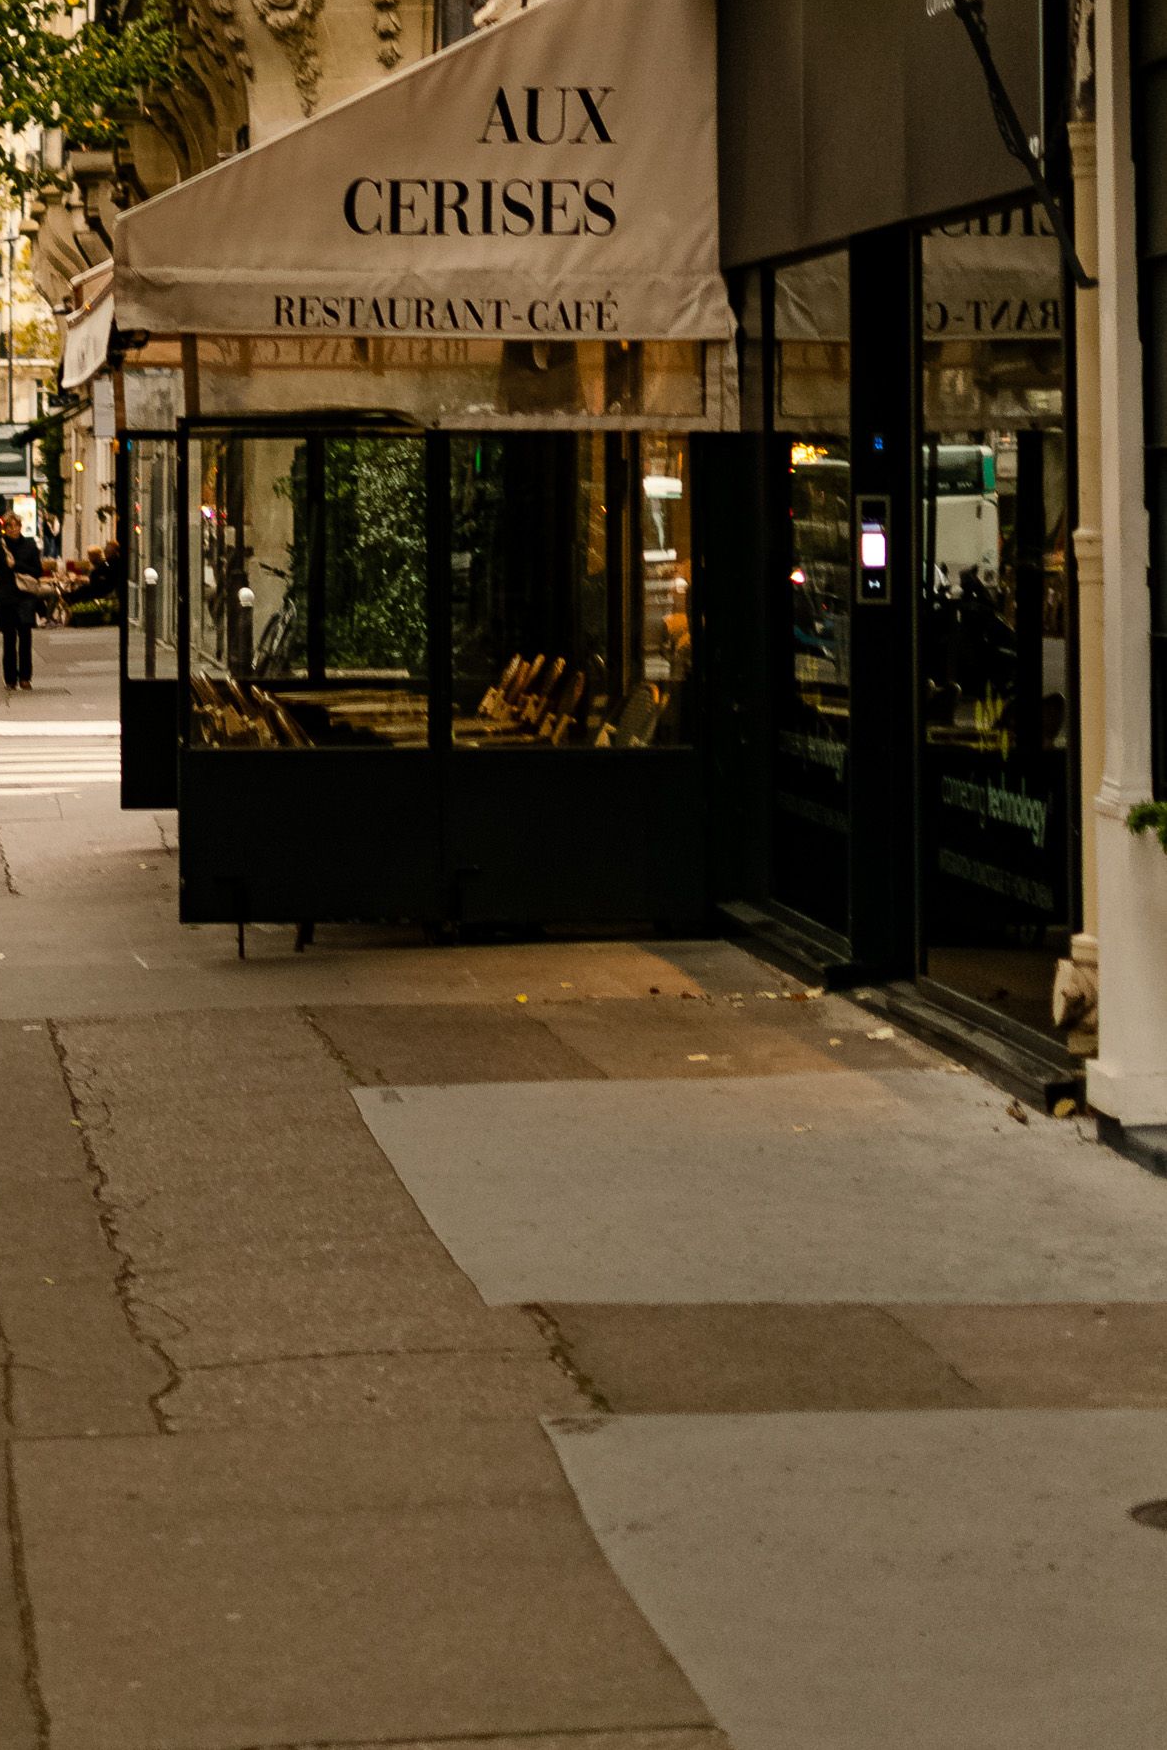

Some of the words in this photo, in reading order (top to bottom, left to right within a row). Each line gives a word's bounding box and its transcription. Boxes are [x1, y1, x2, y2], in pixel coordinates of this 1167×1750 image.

[477, 85, 617, 146] AUX
[342, 176, 617, 238] CERISES
[273, 289, 619, 333] RESTAURANT-CAFÉ
[986, 771, 1047, 850] technology
